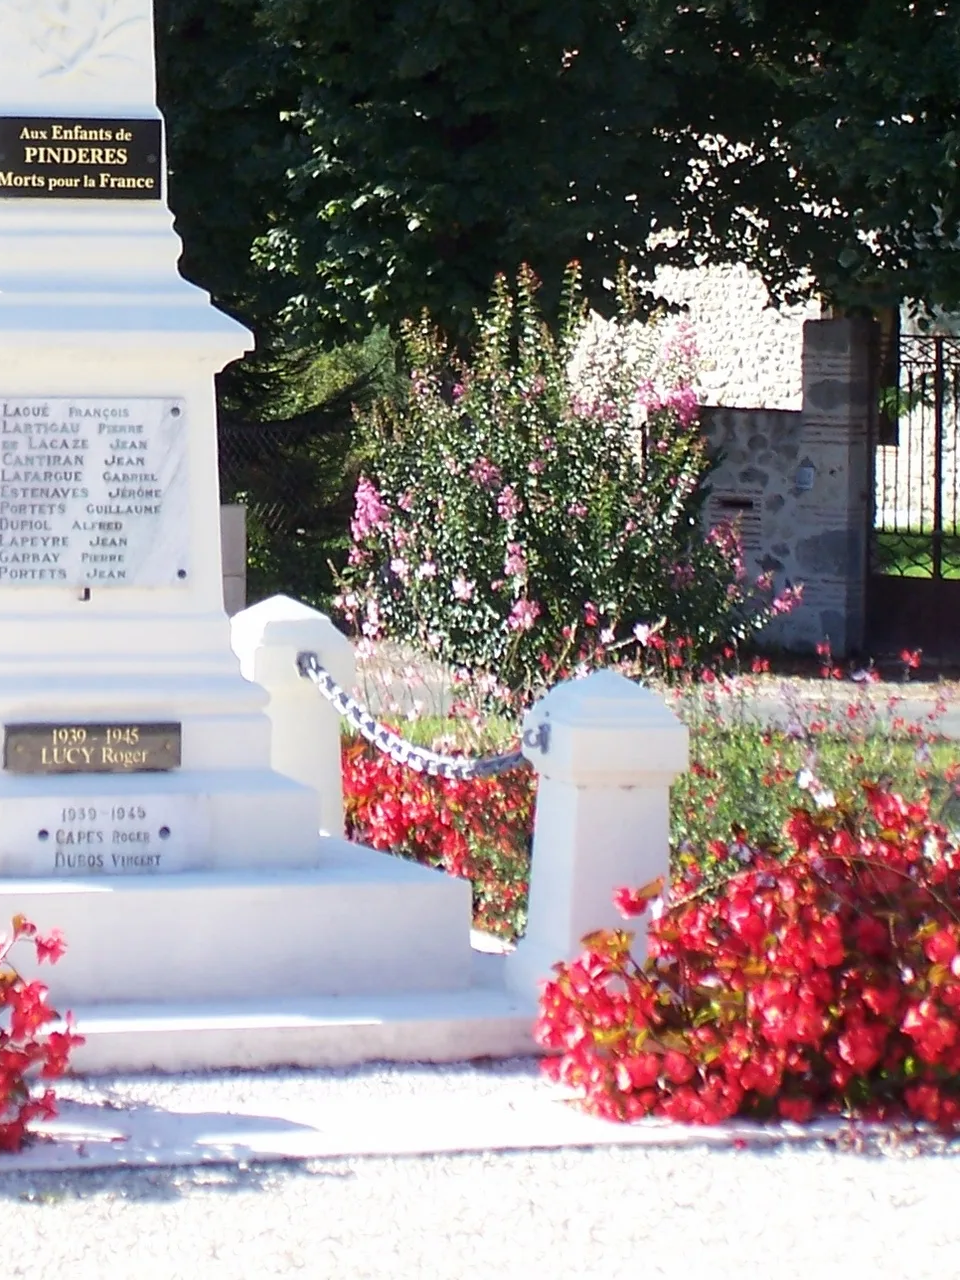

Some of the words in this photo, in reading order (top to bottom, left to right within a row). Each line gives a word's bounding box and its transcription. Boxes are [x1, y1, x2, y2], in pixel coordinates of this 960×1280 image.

[20, 127, 47, 139] Aux
[52, 125, 112, 141] Enfants
[116, 129, 132, 141] de
[25, 147, 127, 164] PINDERES
[49, 177, 80, 190] pour
[83, 175, 95, 187] la
[99, 173, 154, 188] France
[69, 406, 130, 420] FRANÇOIS
[2, 421, 80, 434] LARTIGAU
[98, 423, 143, 435] PIERRE
[28, 437, 88, 450] LACAZE
[110, 439, 147, 450] JEAN
[2, 453, 84, 466] CANTIRAN
[104, 454, 145, 466] JEAN
[1, 469, 82, 482] LAFARGUE
[103, 471, 158, 482] GABRIEL
[1, 485, 89, 499] ESTENAVES
[108, 485, 161, 499] JÉRÔME
[0, 502, 66, 515] PORTETS
[86, 503, 161, 515] GUILLAUME
[72, 519, 122, 531] ALFRED
[0, 534, 69, 548] LAPEYRE
[90, 535, 127, 547] JEAN
[81, 552, 124, 563] PIERRE
[86, 568, 126, 580] JEAN
[53, 729, 87, 745] 1939
[106, 728, 139, 745] 1945
[41, 747, 94, 764] LUCY
[102, 747, 148, 767] Roger
[112, 830, 150, 843] ROGER
[55, 852, 104, 867] DUBOS
[112, 853, 161, 867] VINCENT
